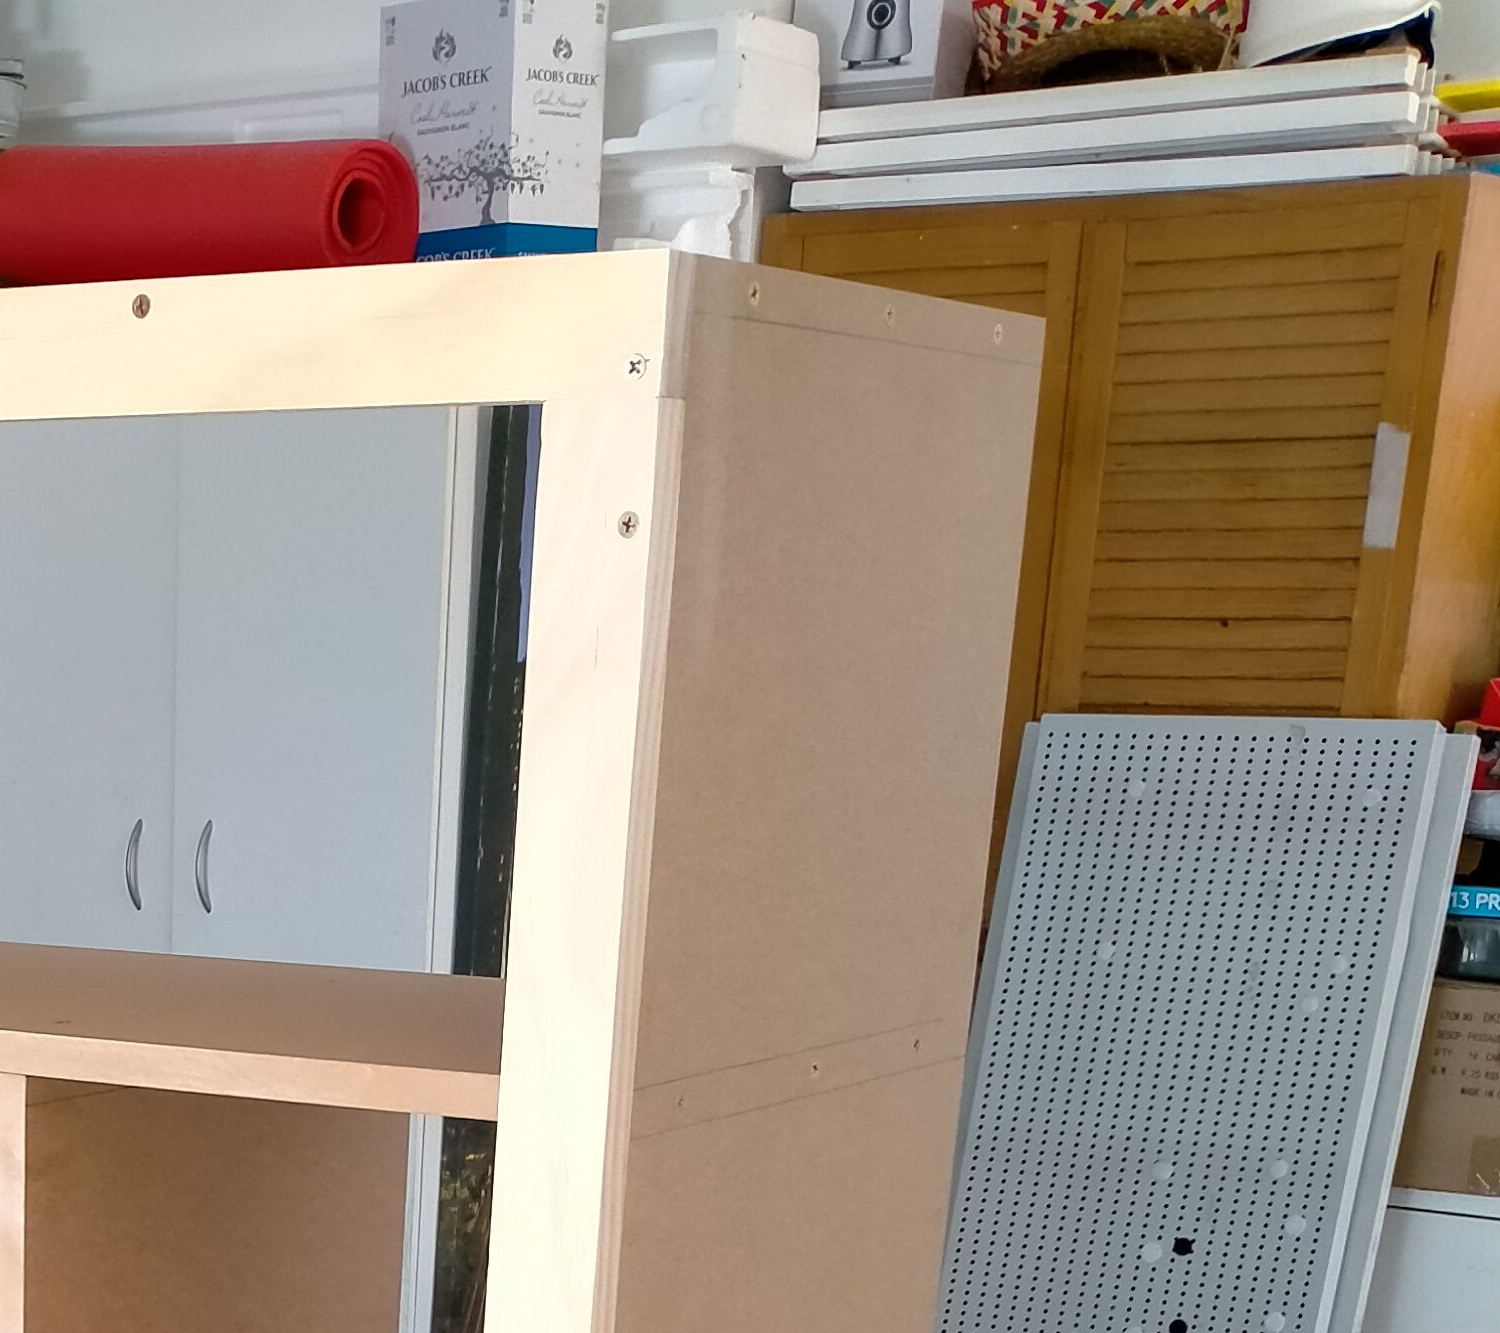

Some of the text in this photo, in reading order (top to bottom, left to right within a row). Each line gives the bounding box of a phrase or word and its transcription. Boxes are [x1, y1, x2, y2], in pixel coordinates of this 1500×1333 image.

[401, 66, 492, 98] JACOB'S CREEK
[525, 67, 600, 86] JACOB'S CREEK
